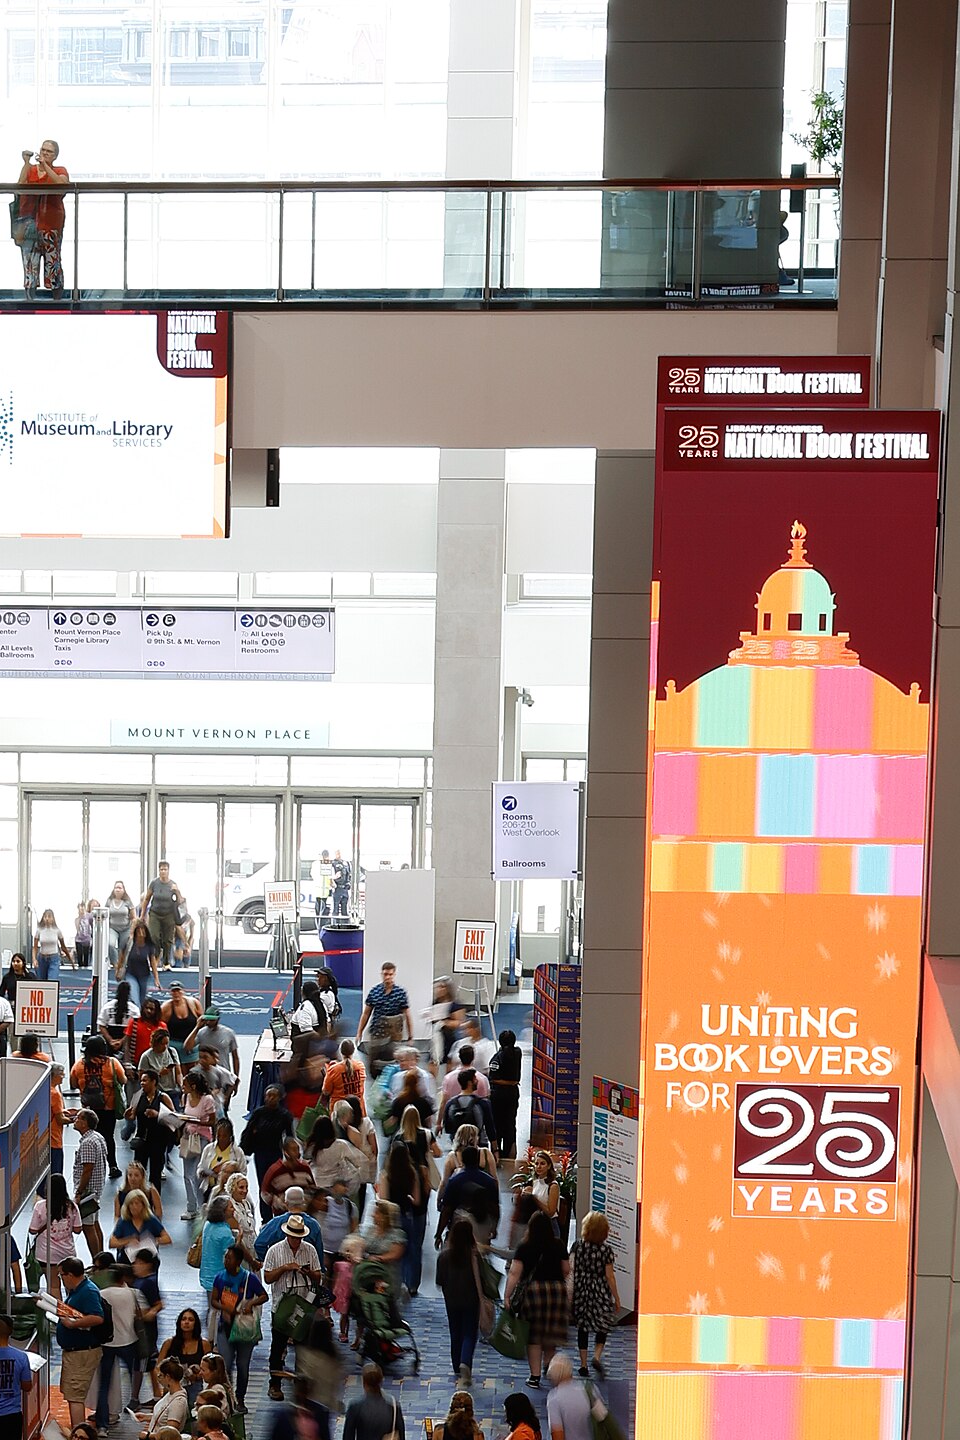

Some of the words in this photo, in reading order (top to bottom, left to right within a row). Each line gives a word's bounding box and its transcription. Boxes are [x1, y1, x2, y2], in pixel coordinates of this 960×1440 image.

[167, 316, 216, 334] NATIONAL
[167, 333, 197, 351] BOOK
[167, 350, 214, 368] FESTIVAL
[668, 368, 700, 386] 25
[704, 373, 765, 394] NATIONAL
[766, 373, 804, 394] BOOK
[804, 373, 862, 394] FESTIVAL
[37, 413, 86, 422] INSTITUTE
[89, 413, 99, 422] of
[20, 420, 96, 436] Museum
[96, 428, 112, 436] and
[112, 420, 174, 440] Library
[678, 426, 720, 449] 25
[726, 425, 762, 433] LIBRARY
[764, 425, 775, 433] OF
[776, 425, 824, 433] CONGRESS
[112, 438, 162, 448] SERVICES
[724, 433, 804, 459] NATIONAL
[806, 433, 854, 459] BOOK
[855, 433, 930, 460] FESTIVAL
[678, 450, 718, 458] YEARS
[128, 728, 185, 738] MOUNT
[192, 729, 256, 739] VERNON
[265, 730, 312, 740] PLACE
[466, 930, 486, 945] EXIT
[464, 946, 486, 960] ONLY
[30, 990, 44, 1006] NO
[21, 1006, 52, 1023] ENTRY
[701, 1004, 858, 1039] UNITING
[654, 1043, 750, 1072] BOOK
[758, 1044, 892, 1076] LOVERS
[593, 1110, 608, 1158] WEST
[666, 1081, 731, 1109] FOR
[738, 1088, 896, 1178] 25
[592, 1161, 607, 1215] SALON
[738, 1185, 889, 1214] YEARS
